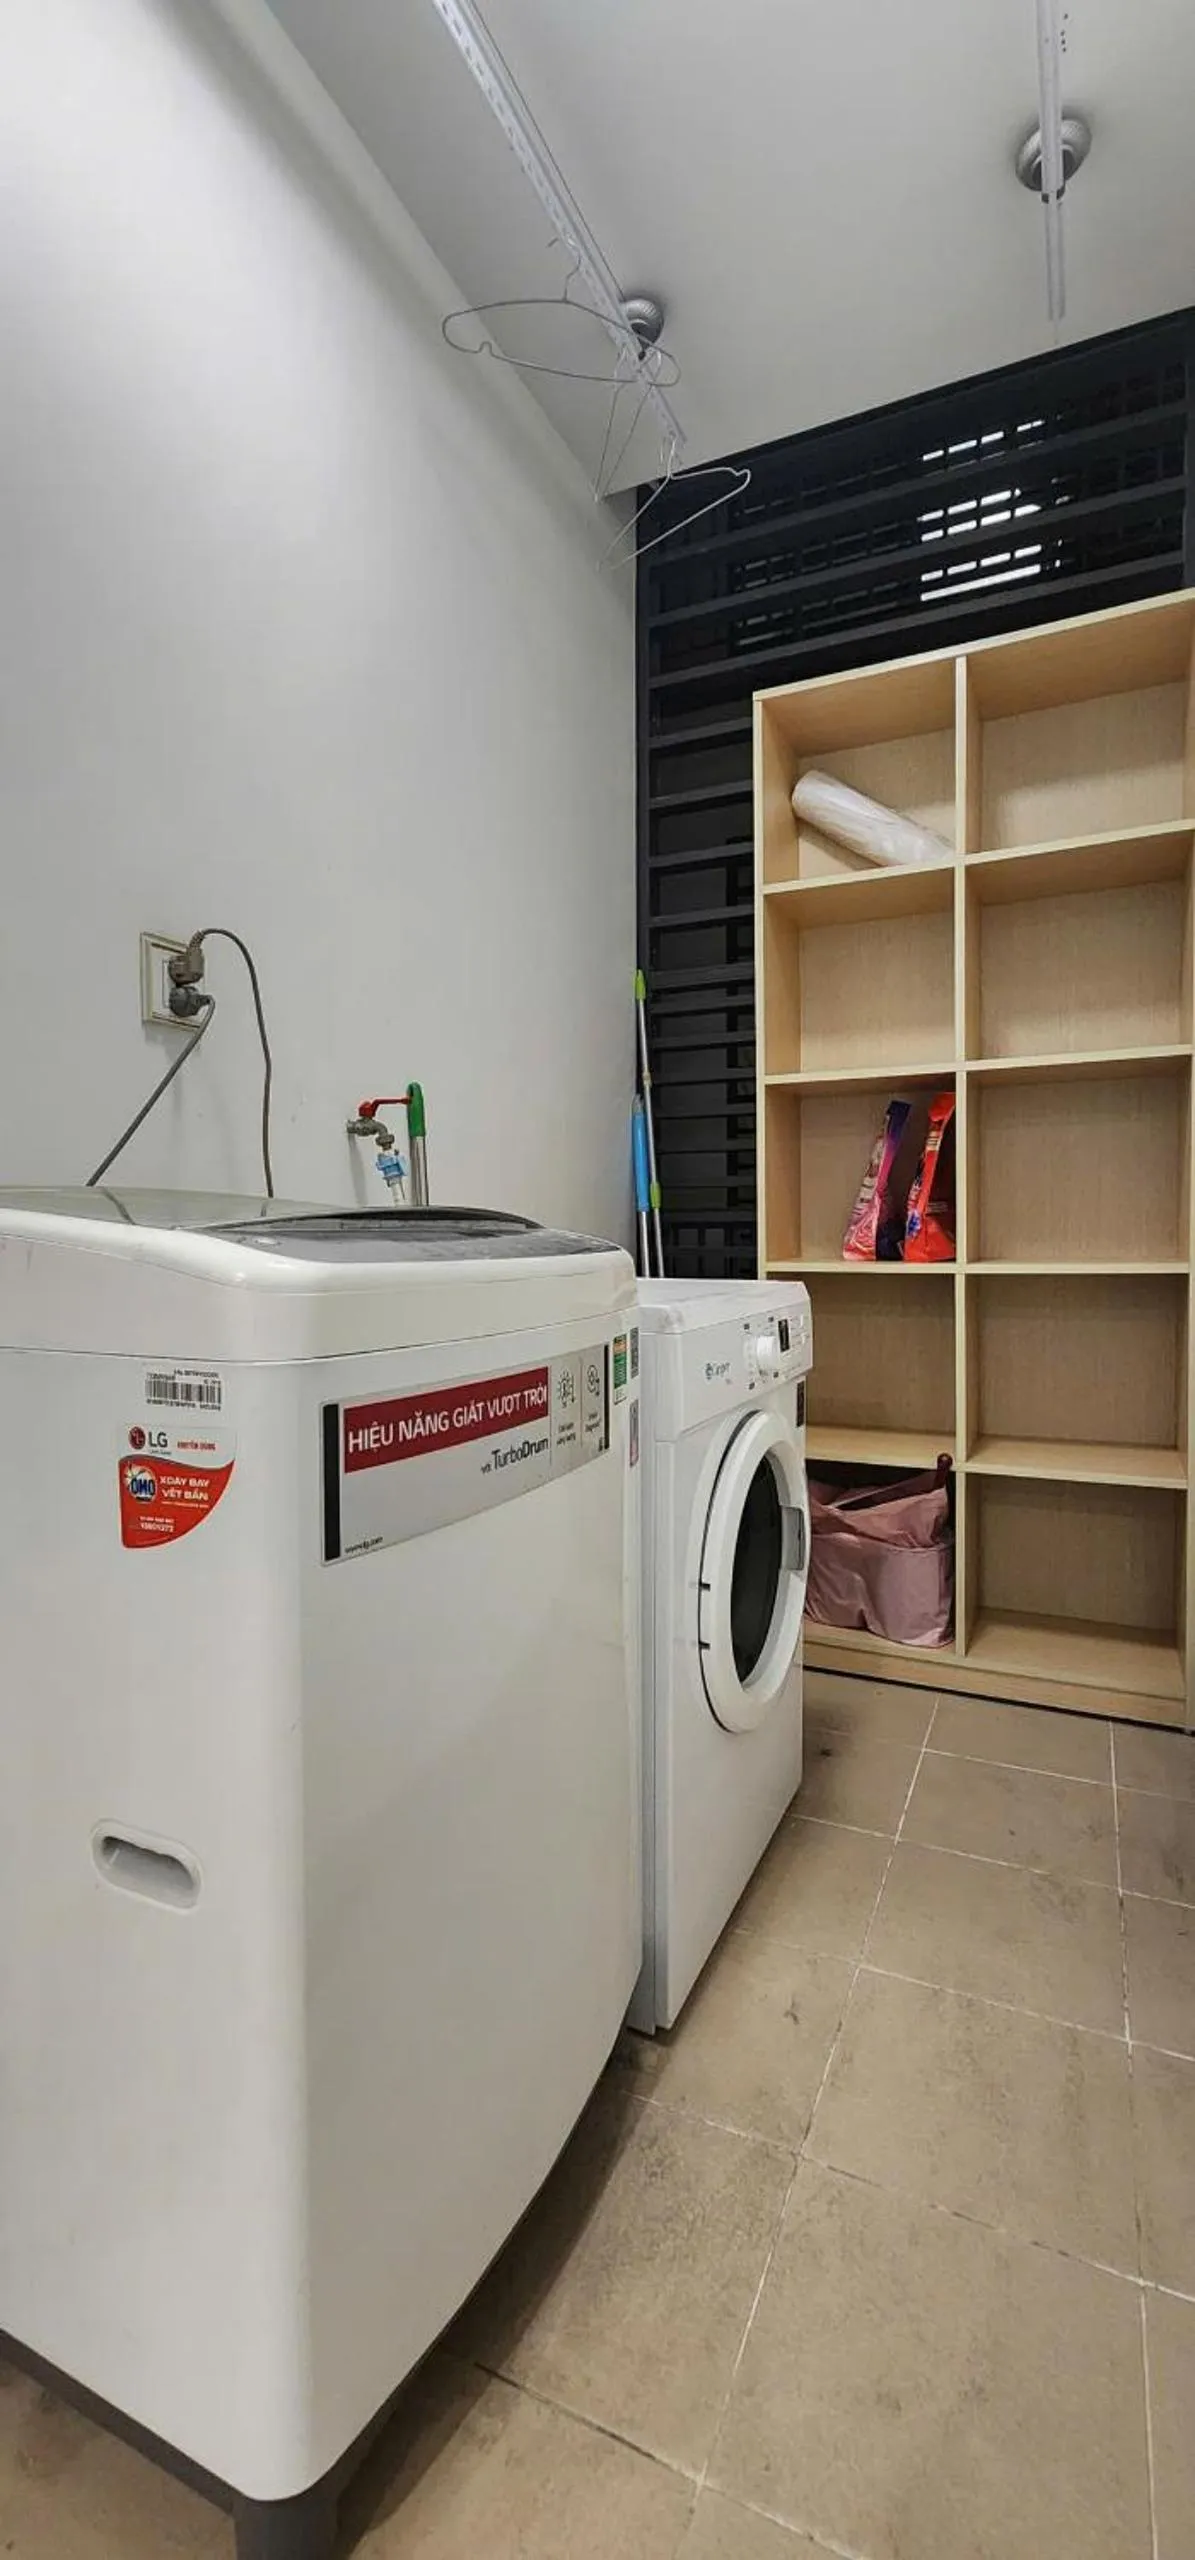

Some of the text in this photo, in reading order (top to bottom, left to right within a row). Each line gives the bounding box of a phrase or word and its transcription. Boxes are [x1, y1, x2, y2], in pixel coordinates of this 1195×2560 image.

[148, 1431, 168, 1448] LG
[348, 1421, 394, 1453] HIỆU
[398, 1410, 450, 1443] NĂNG
[491, 1438, 548, 1470] TurboDrum
[131, 1479, 156, 1496] OMO
[160, 1475, 210, 1488] XOAY BAY
